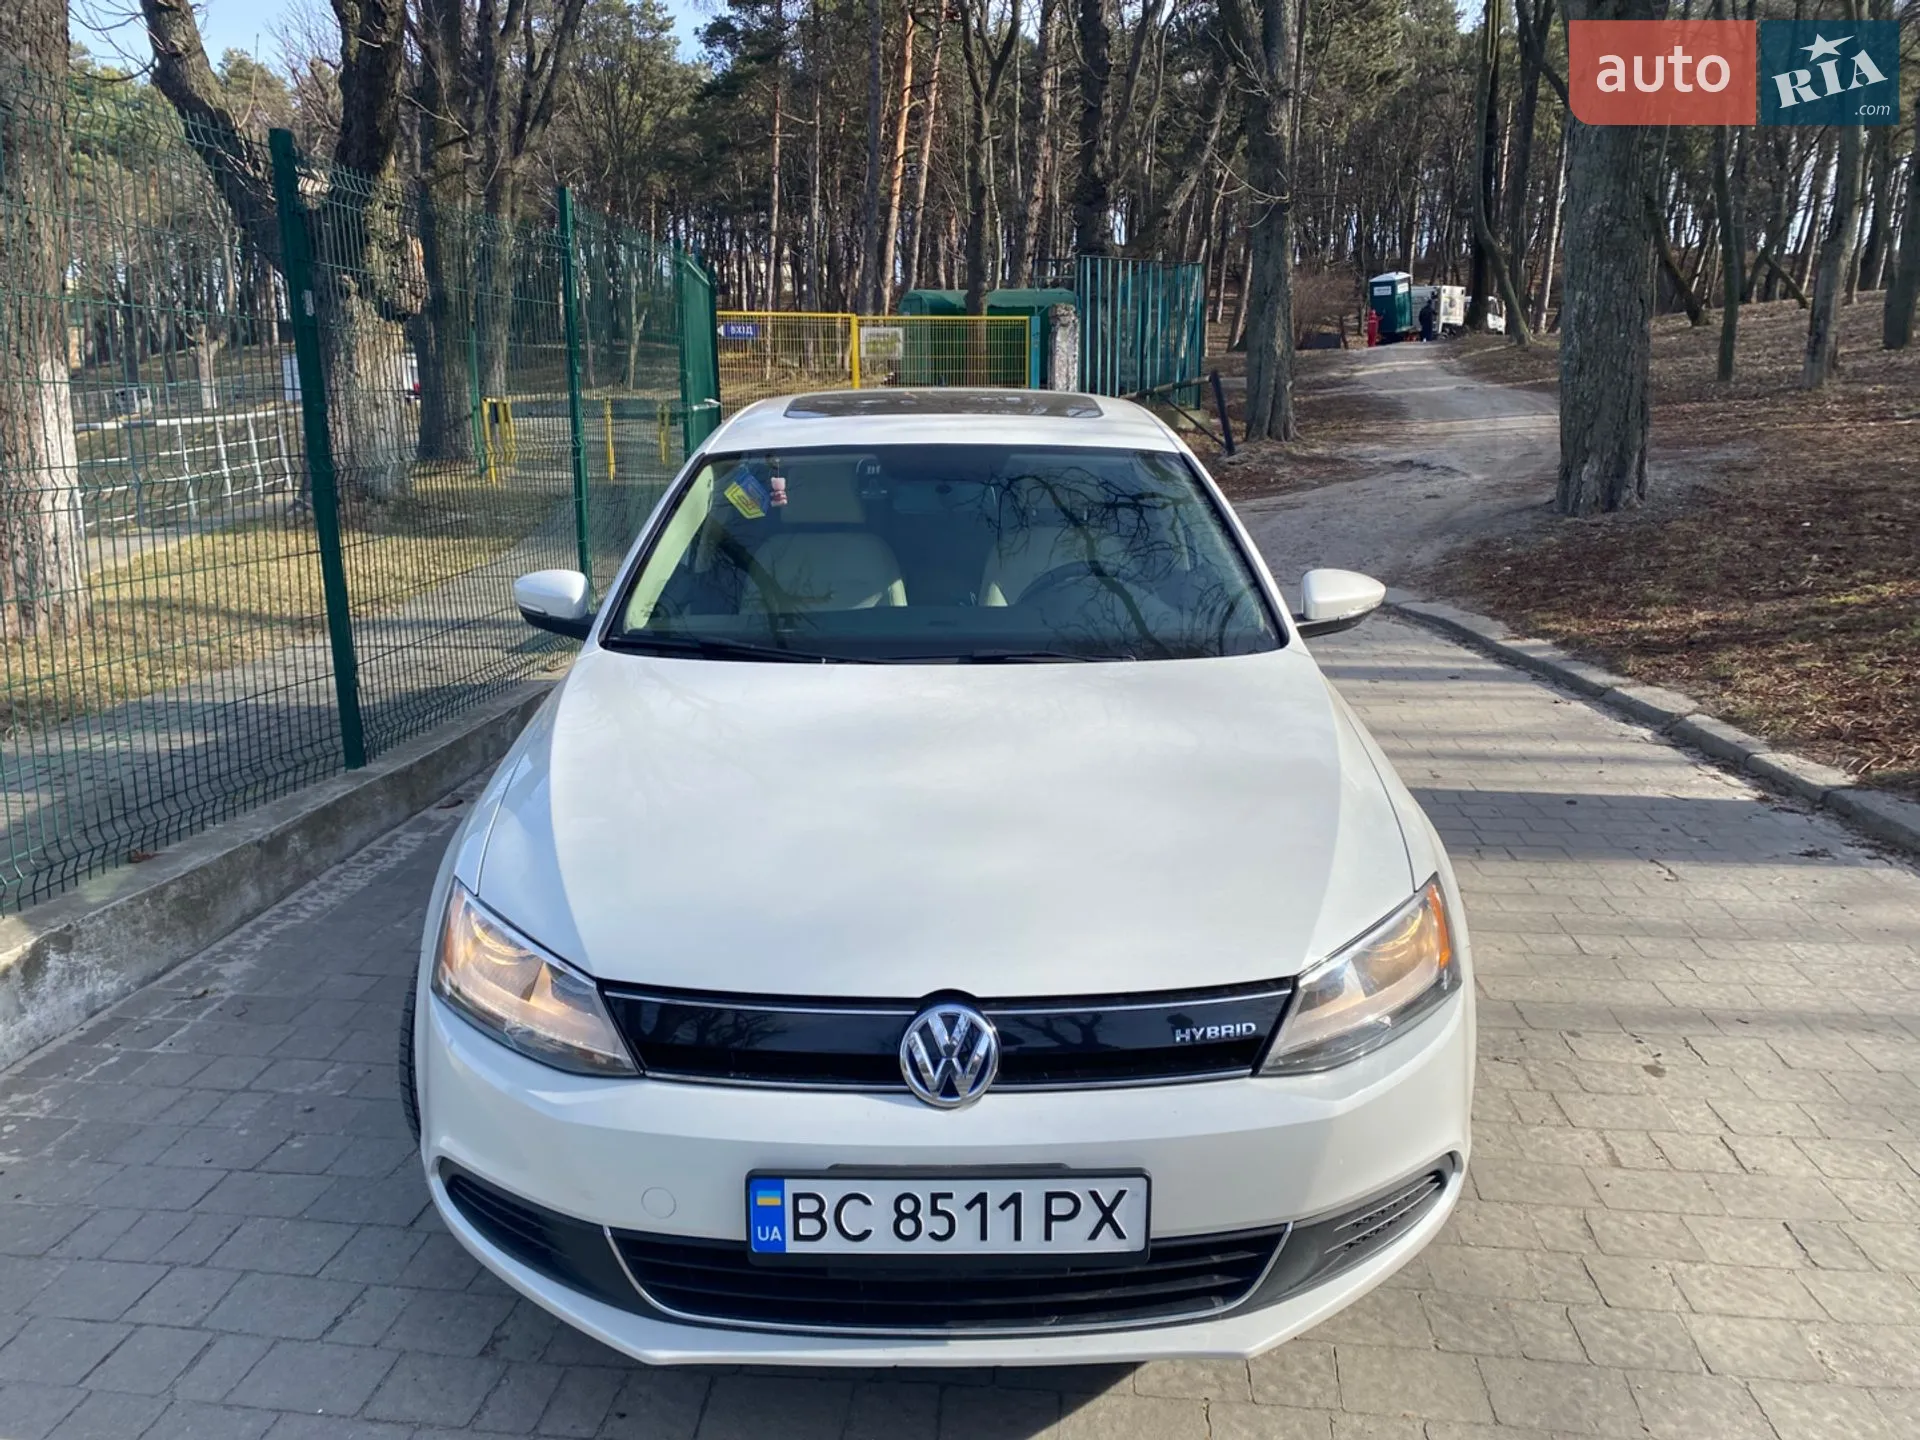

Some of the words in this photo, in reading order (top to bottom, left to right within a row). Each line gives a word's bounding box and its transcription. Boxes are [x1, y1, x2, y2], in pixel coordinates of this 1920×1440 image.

[1175, 1022, 1257, 1043] HYBRID
[792, 1191, 874, 1242] BC
[892, 1191, 1024, 1242] 8511
[1043, 1188, 1129, 1242] PX
[757, 1225, 783, 1242] UA
